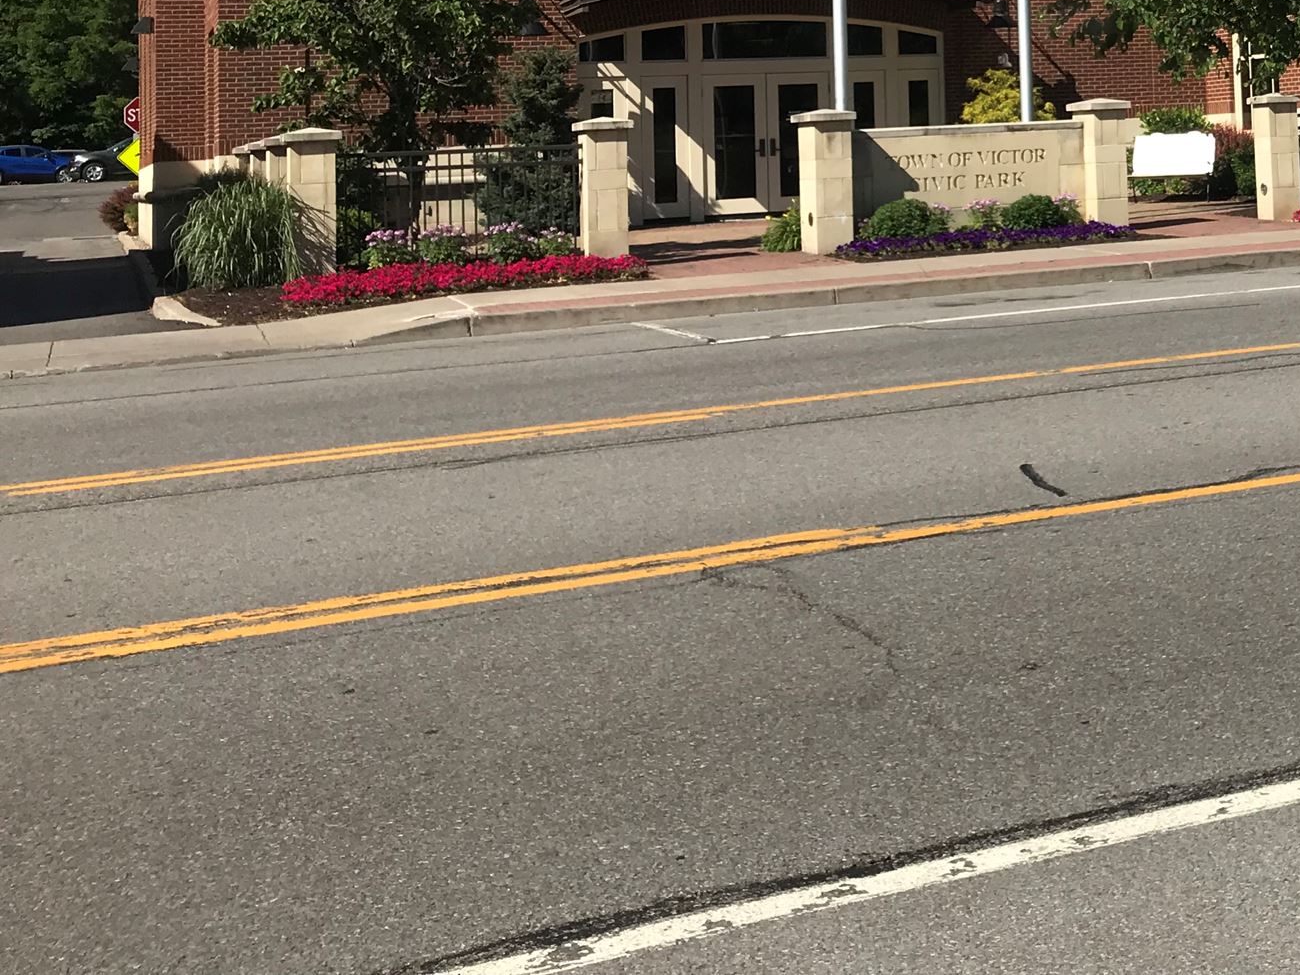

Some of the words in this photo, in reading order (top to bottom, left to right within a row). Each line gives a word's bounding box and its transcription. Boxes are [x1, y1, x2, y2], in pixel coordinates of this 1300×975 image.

[948, 152, 973, 168] OF
[977, 148, 1046, 167] VICTOR
[975, 171, 1027, 190] PARK
